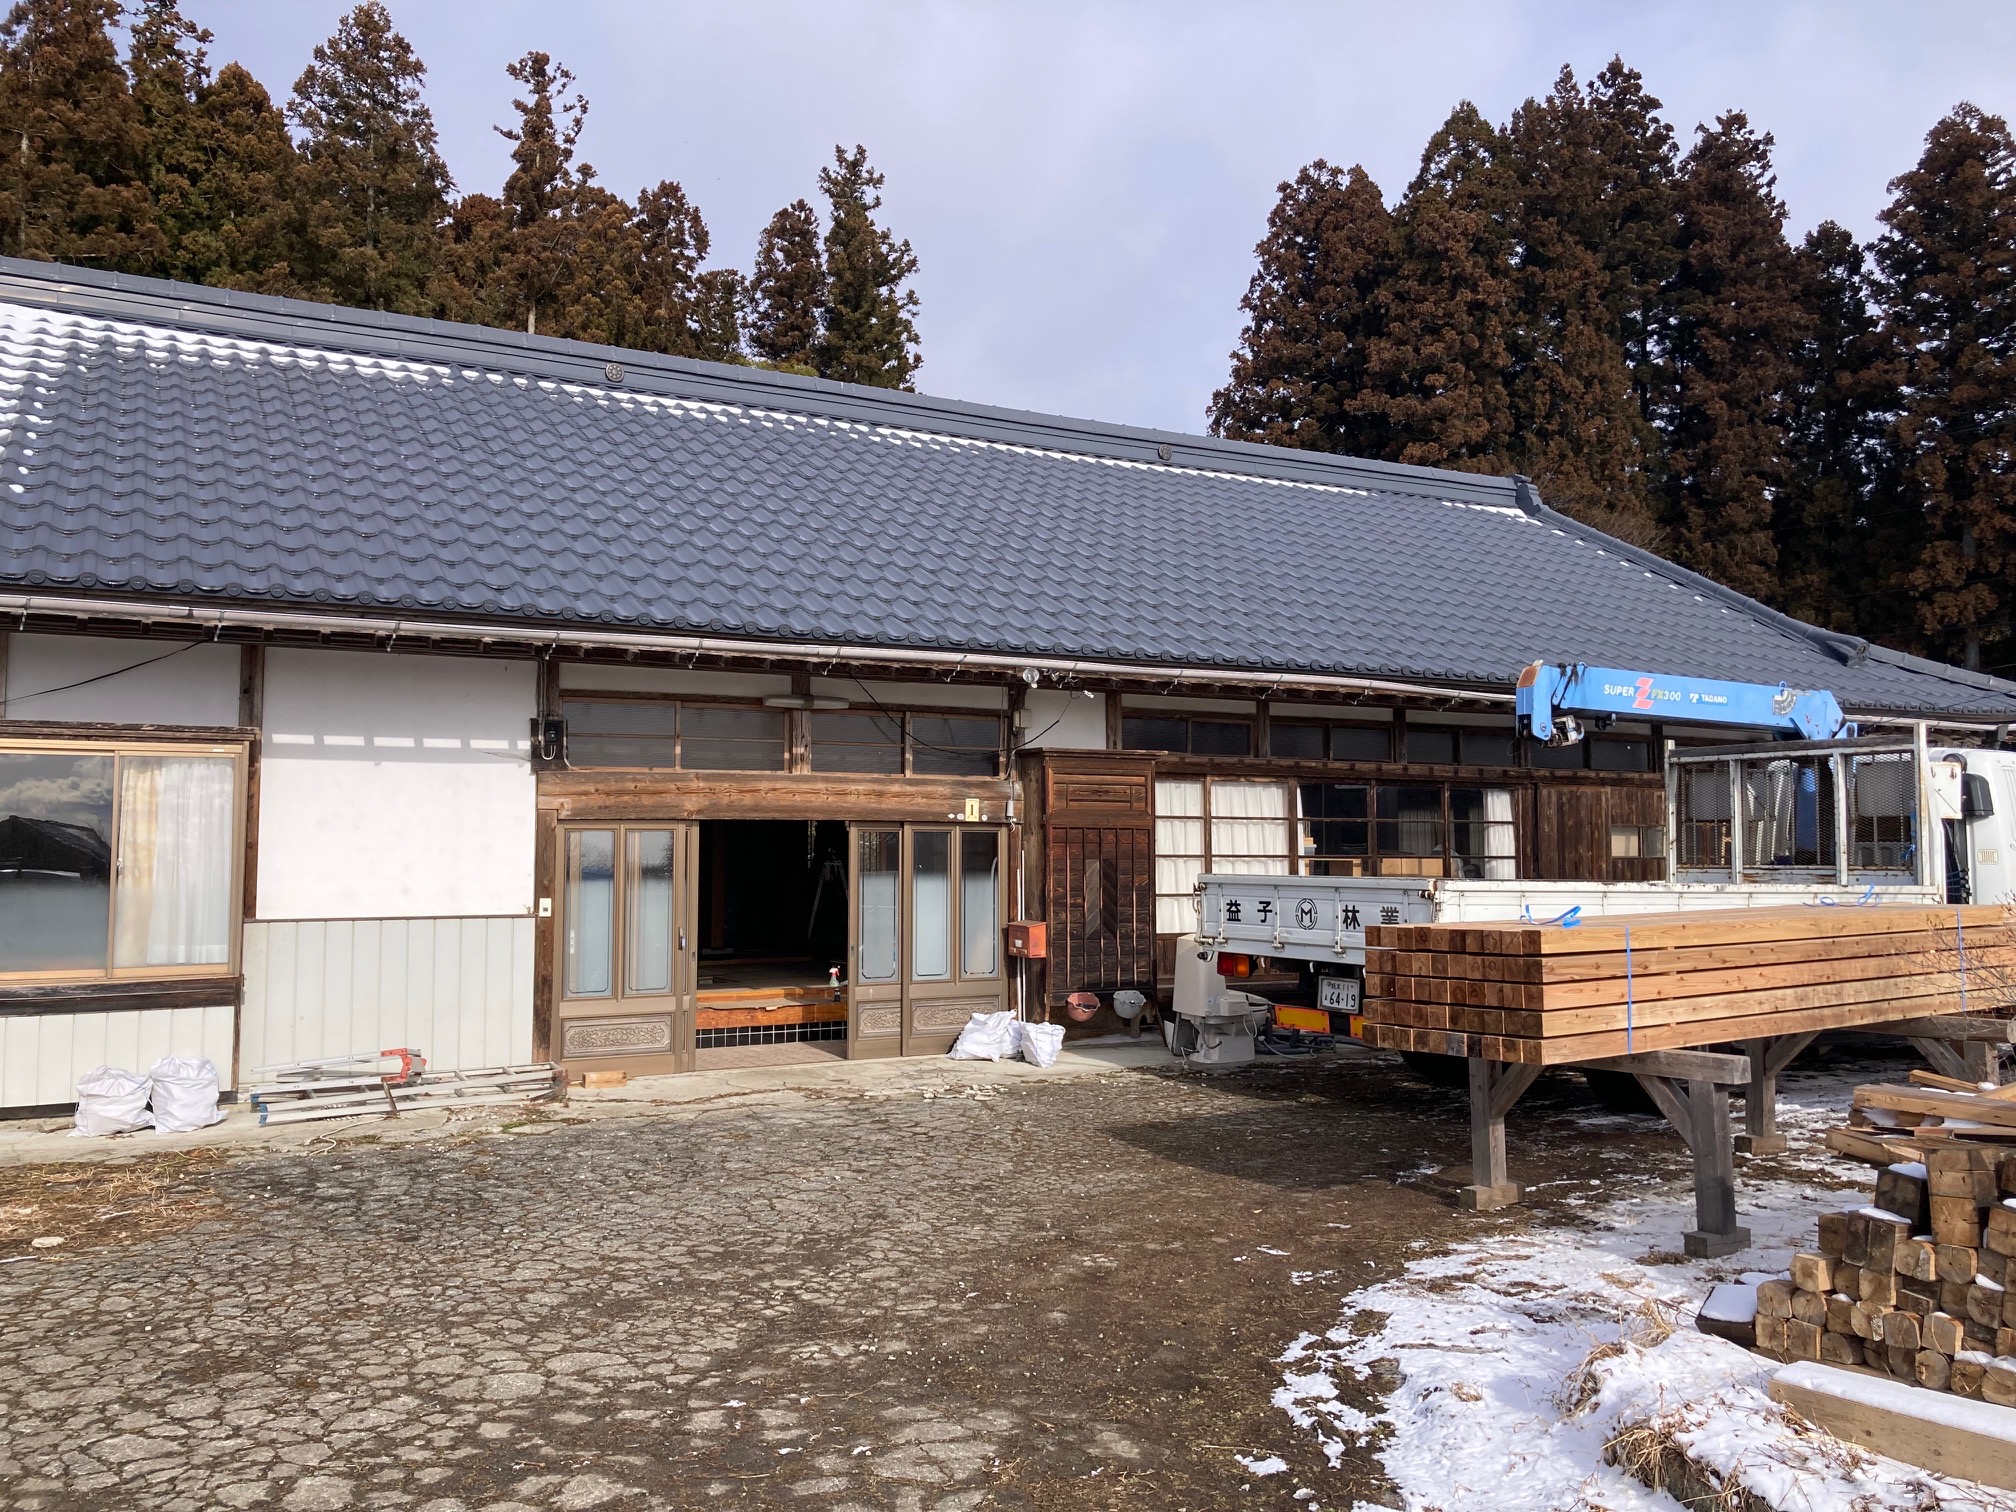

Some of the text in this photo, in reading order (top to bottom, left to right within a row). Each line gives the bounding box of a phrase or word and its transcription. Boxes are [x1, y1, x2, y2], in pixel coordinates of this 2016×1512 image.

[1603, 684, 1635, 697] SUPER
[1700, 694, 1728, 704] TADANO
[1226, 899, 1273, 924] 益子
[1342, 904, 1400, 931] 林業
